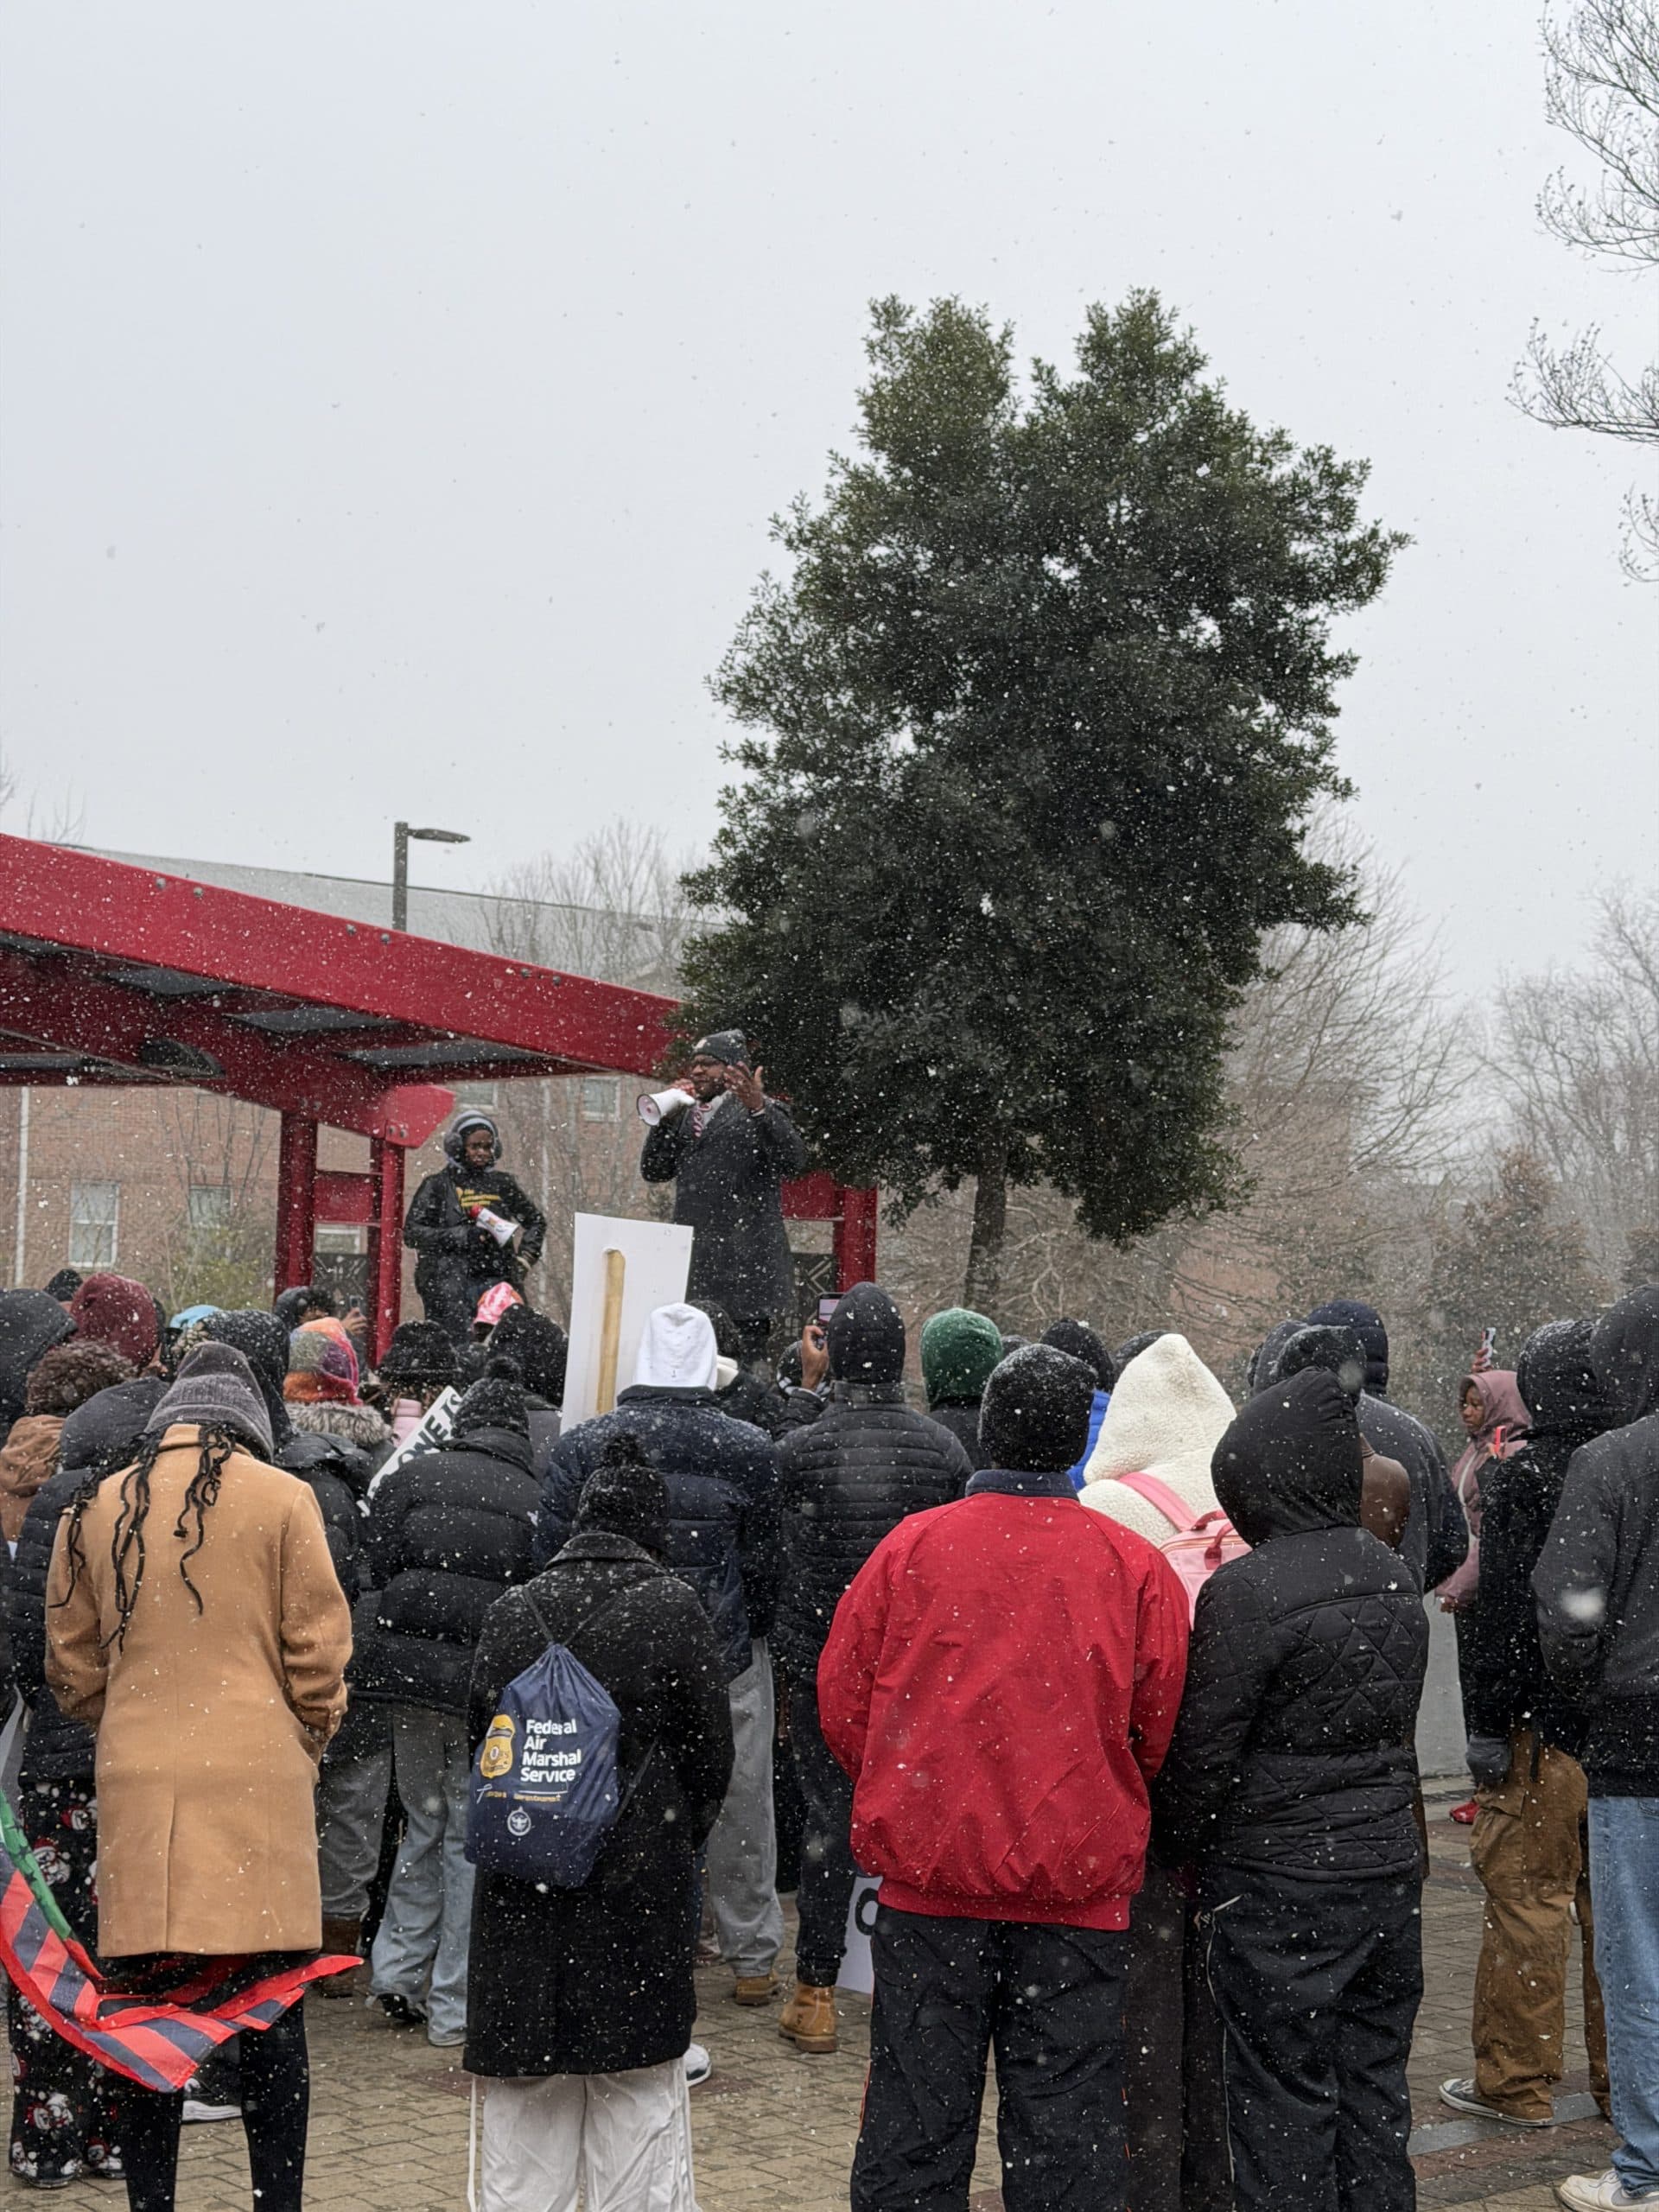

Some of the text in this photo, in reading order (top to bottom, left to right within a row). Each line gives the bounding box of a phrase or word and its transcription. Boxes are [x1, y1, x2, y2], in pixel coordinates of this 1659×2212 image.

[525, 1718, 577, 1735] Federal
[524, 1735, 547, 1751] Air
[522, 1748, 582, 1767] Marshal
[520, 1767, 575, 1783] Service
